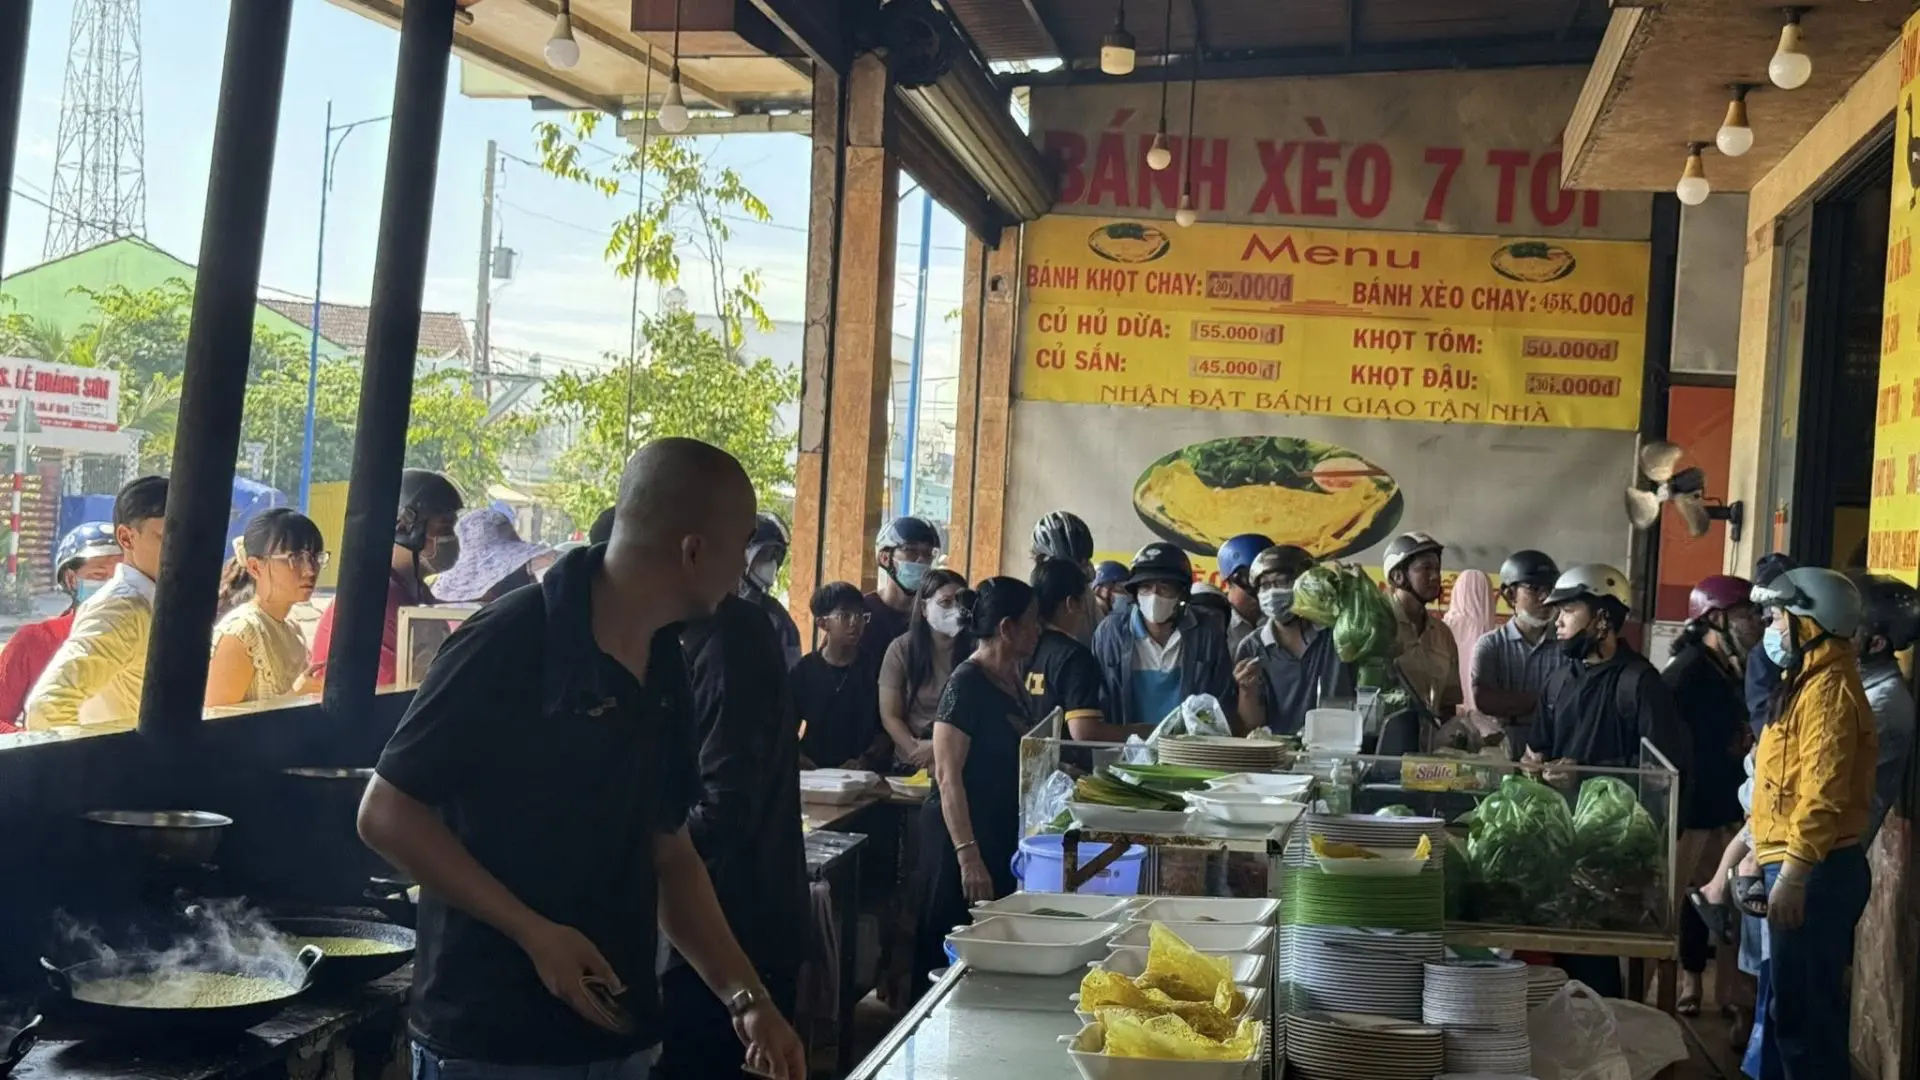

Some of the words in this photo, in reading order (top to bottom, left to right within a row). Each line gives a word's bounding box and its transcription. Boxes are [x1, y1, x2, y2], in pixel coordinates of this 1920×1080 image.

[1045, 108, 1229, 212] BÁNH
[1250, 117, 1392, 219] XÈO
[1422, 147, 1465, 221] 7
[1240, 233, 1421, 269] Menu
[1026, 259, 1079, 290] BÁNH
[1086, 267, 1139, 297] KHỌT
[1145, 272, 1203, 297] CHAY:
[1352, 276, 1412, 307] BÁNH
[1420, 280, 1464, 310] XÈO
[1471, 286, 1537, 313] CHAY:
[1038, 306, 1067, 333] CỦ
[1077, 308, 1107, 336] HỦ
[1117, 311, 1171, 339] DỪA:
[1036, 342, 1065, 370] CỦ
[1074, 342, 1127, 373] SẮN:
[1353, 328, 1417, 355] KHỌT
[1424, 327, 1483, 354] TÔM:
[1526, 338, 1612, 360] 50.000đ
[1351, 364, 1414, 391] KHỌT
[1422, 364, 1477, 392] ĐẬU:
[1100, 384, 1178, 408] NHẬN
[1188, 387, 1246, 410] ĐẶT
[1255, 389, 1333, 412] BÁNH
[1343, 395, 1416, 416] GIAO
[1424, 398, 1480, 423] TẬN
[1492, 400, 1550, 423] NHÀ
[1415, 764, 1453, 780] Solite
